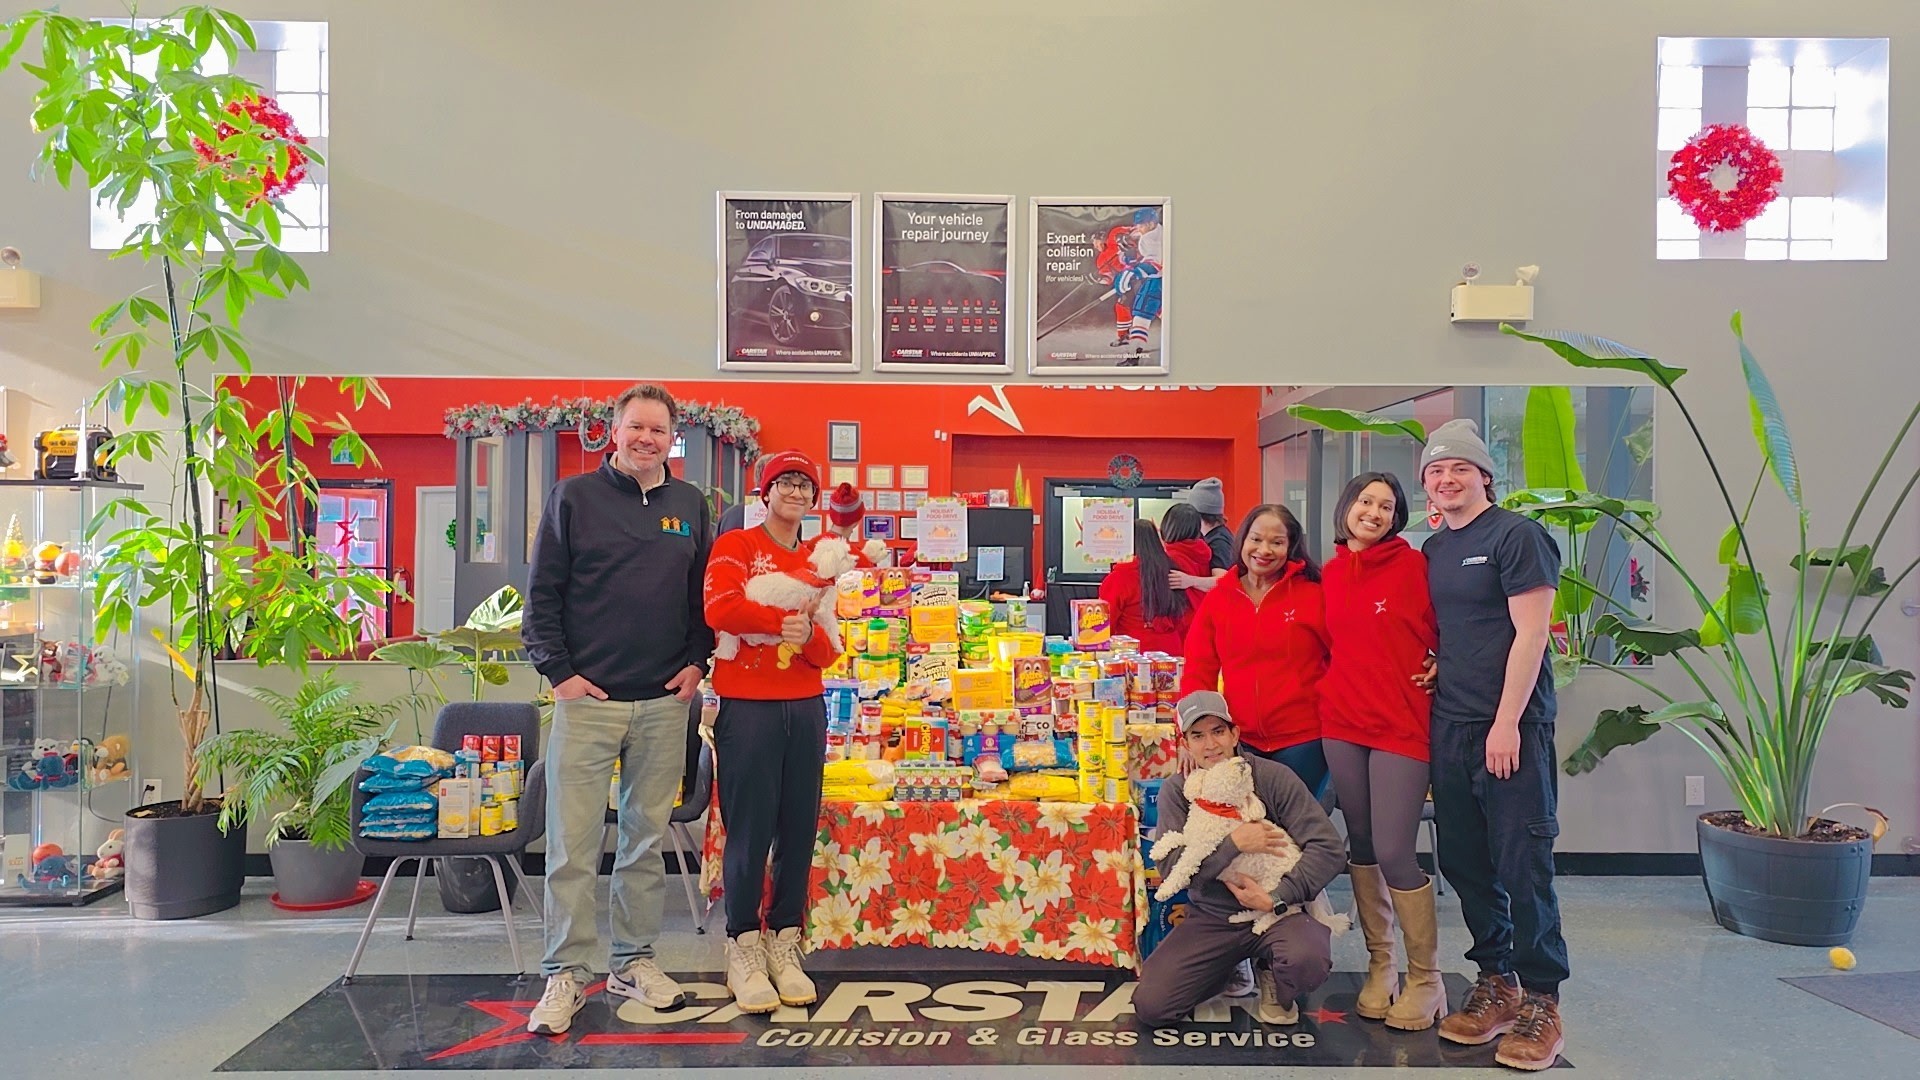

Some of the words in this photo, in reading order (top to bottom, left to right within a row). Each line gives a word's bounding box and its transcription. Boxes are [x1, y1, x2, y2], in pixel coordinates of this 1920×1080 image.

[735, 210, 759, 220] From
[760, 210, 803, 222] damaged
[907, 212, 936, 225] Your
[939, 213, 984, 226] vehicle
[735, 221, 745, 230] to
[746, 220, 806, 230] UNDAMAGED.
[901, 228, 939, 242] repair
[941, 229, 989, 243] journey
[1046, 232, 1086, 245] Expert
[1046, 247, 1094, 257] collision
[1046, 260, 1081, 273] repair
[1045, 274, 1057, 283] (for
[1057, 274, 1084, 283] vehicles)
[756, 1026, 952, 1047] Collision
[966, 1027, 999, 1046] &
[1016, 1027, 1138, 1047] Glass
[1152, 1027, 1317, 1048] Service
